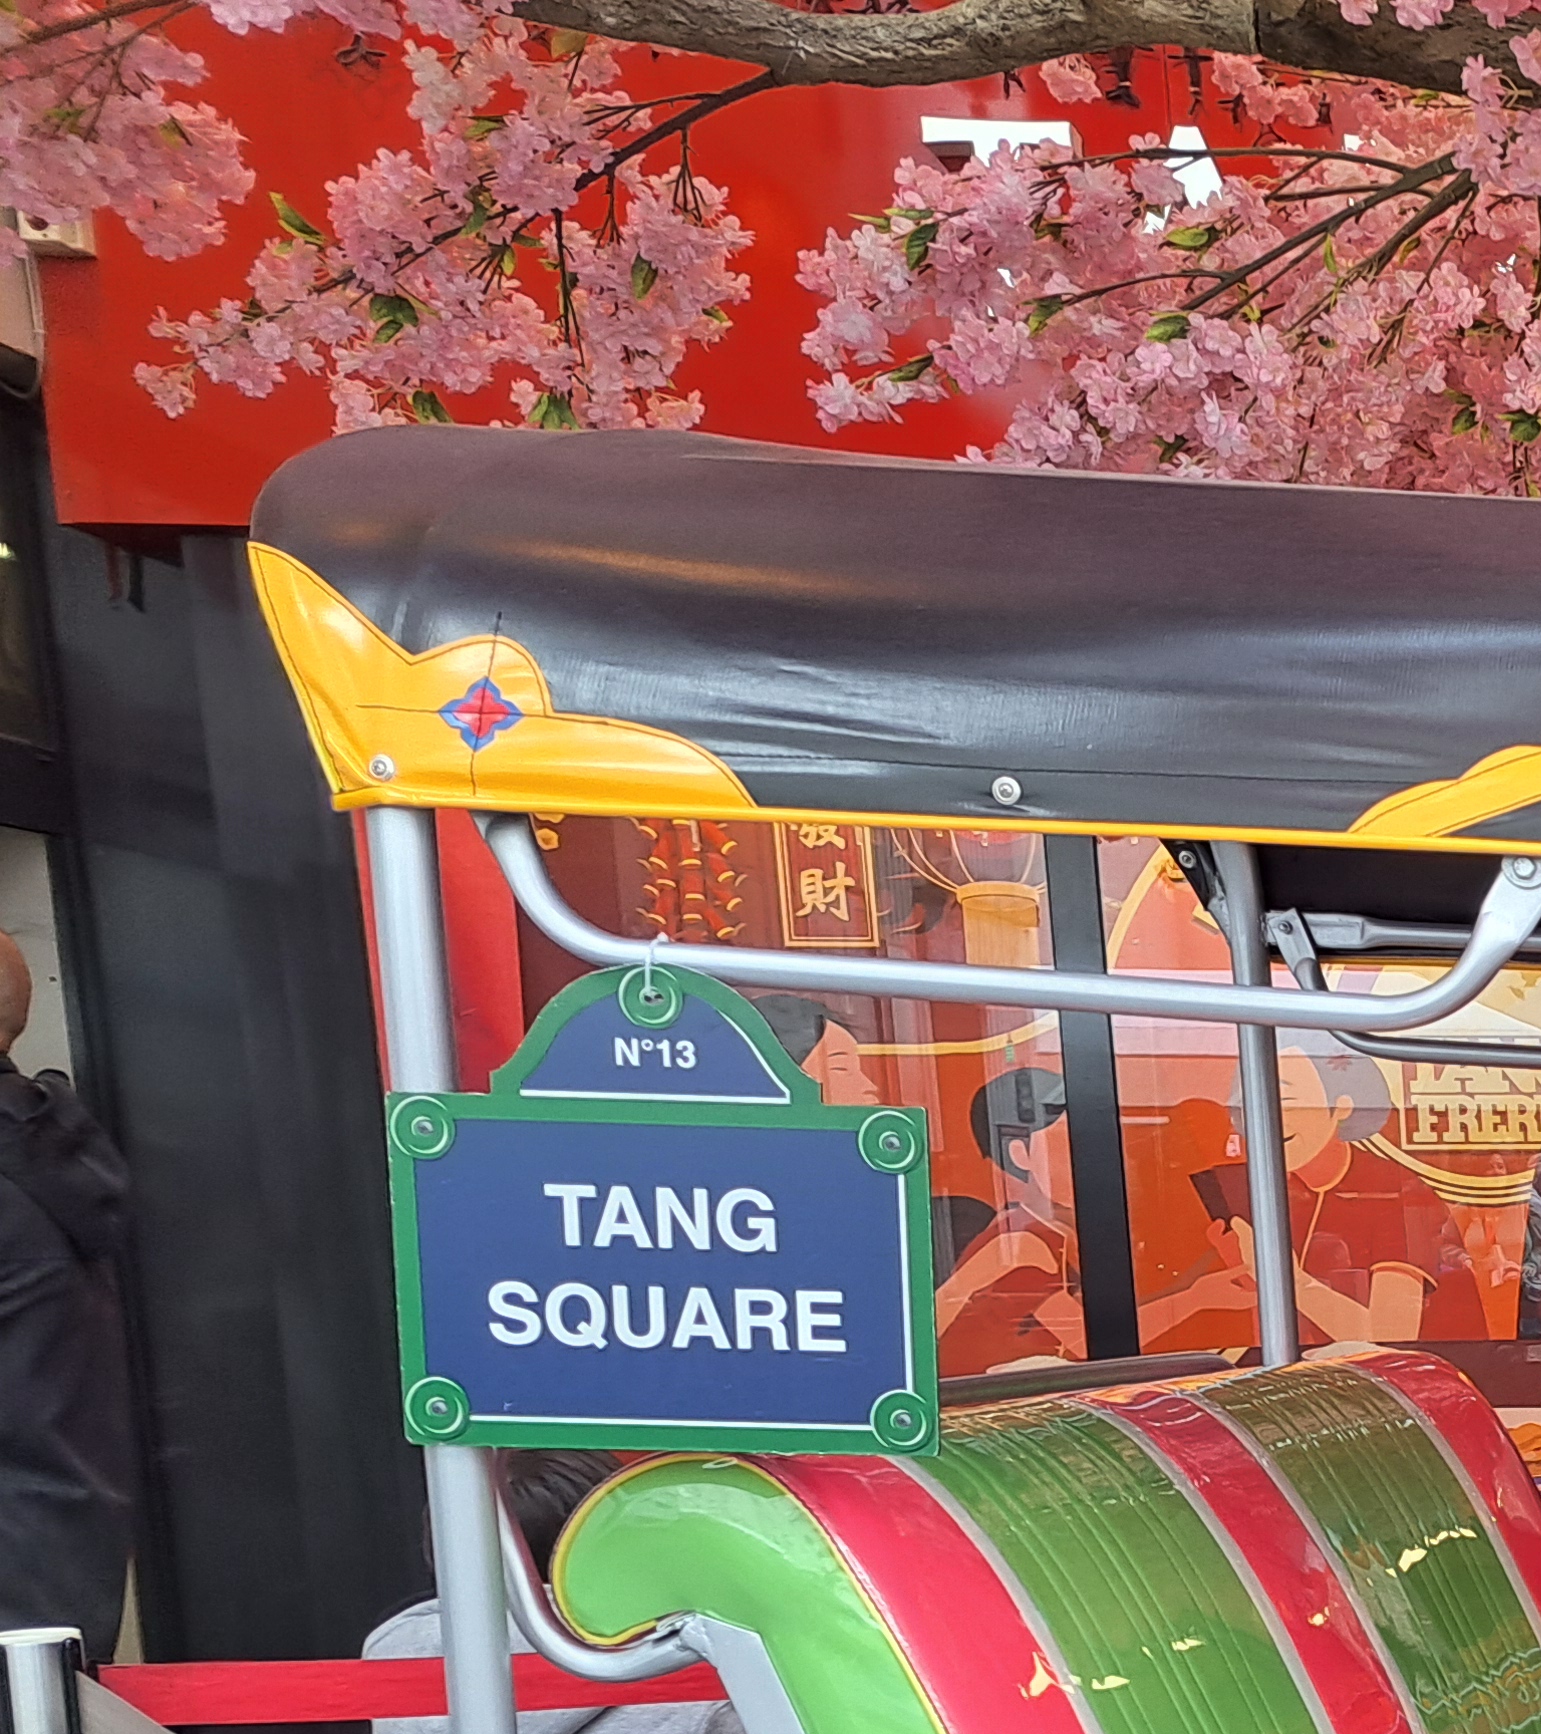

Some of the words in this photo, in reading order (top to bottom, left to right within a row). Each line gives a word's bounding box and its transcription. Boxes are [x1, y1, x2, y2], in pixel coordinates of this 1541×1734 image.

[613, 1035, 697, 1070] N°13
[543, 1182, 779, 1253] TANG
[487, 1281, 848, 1354] SQUARE
